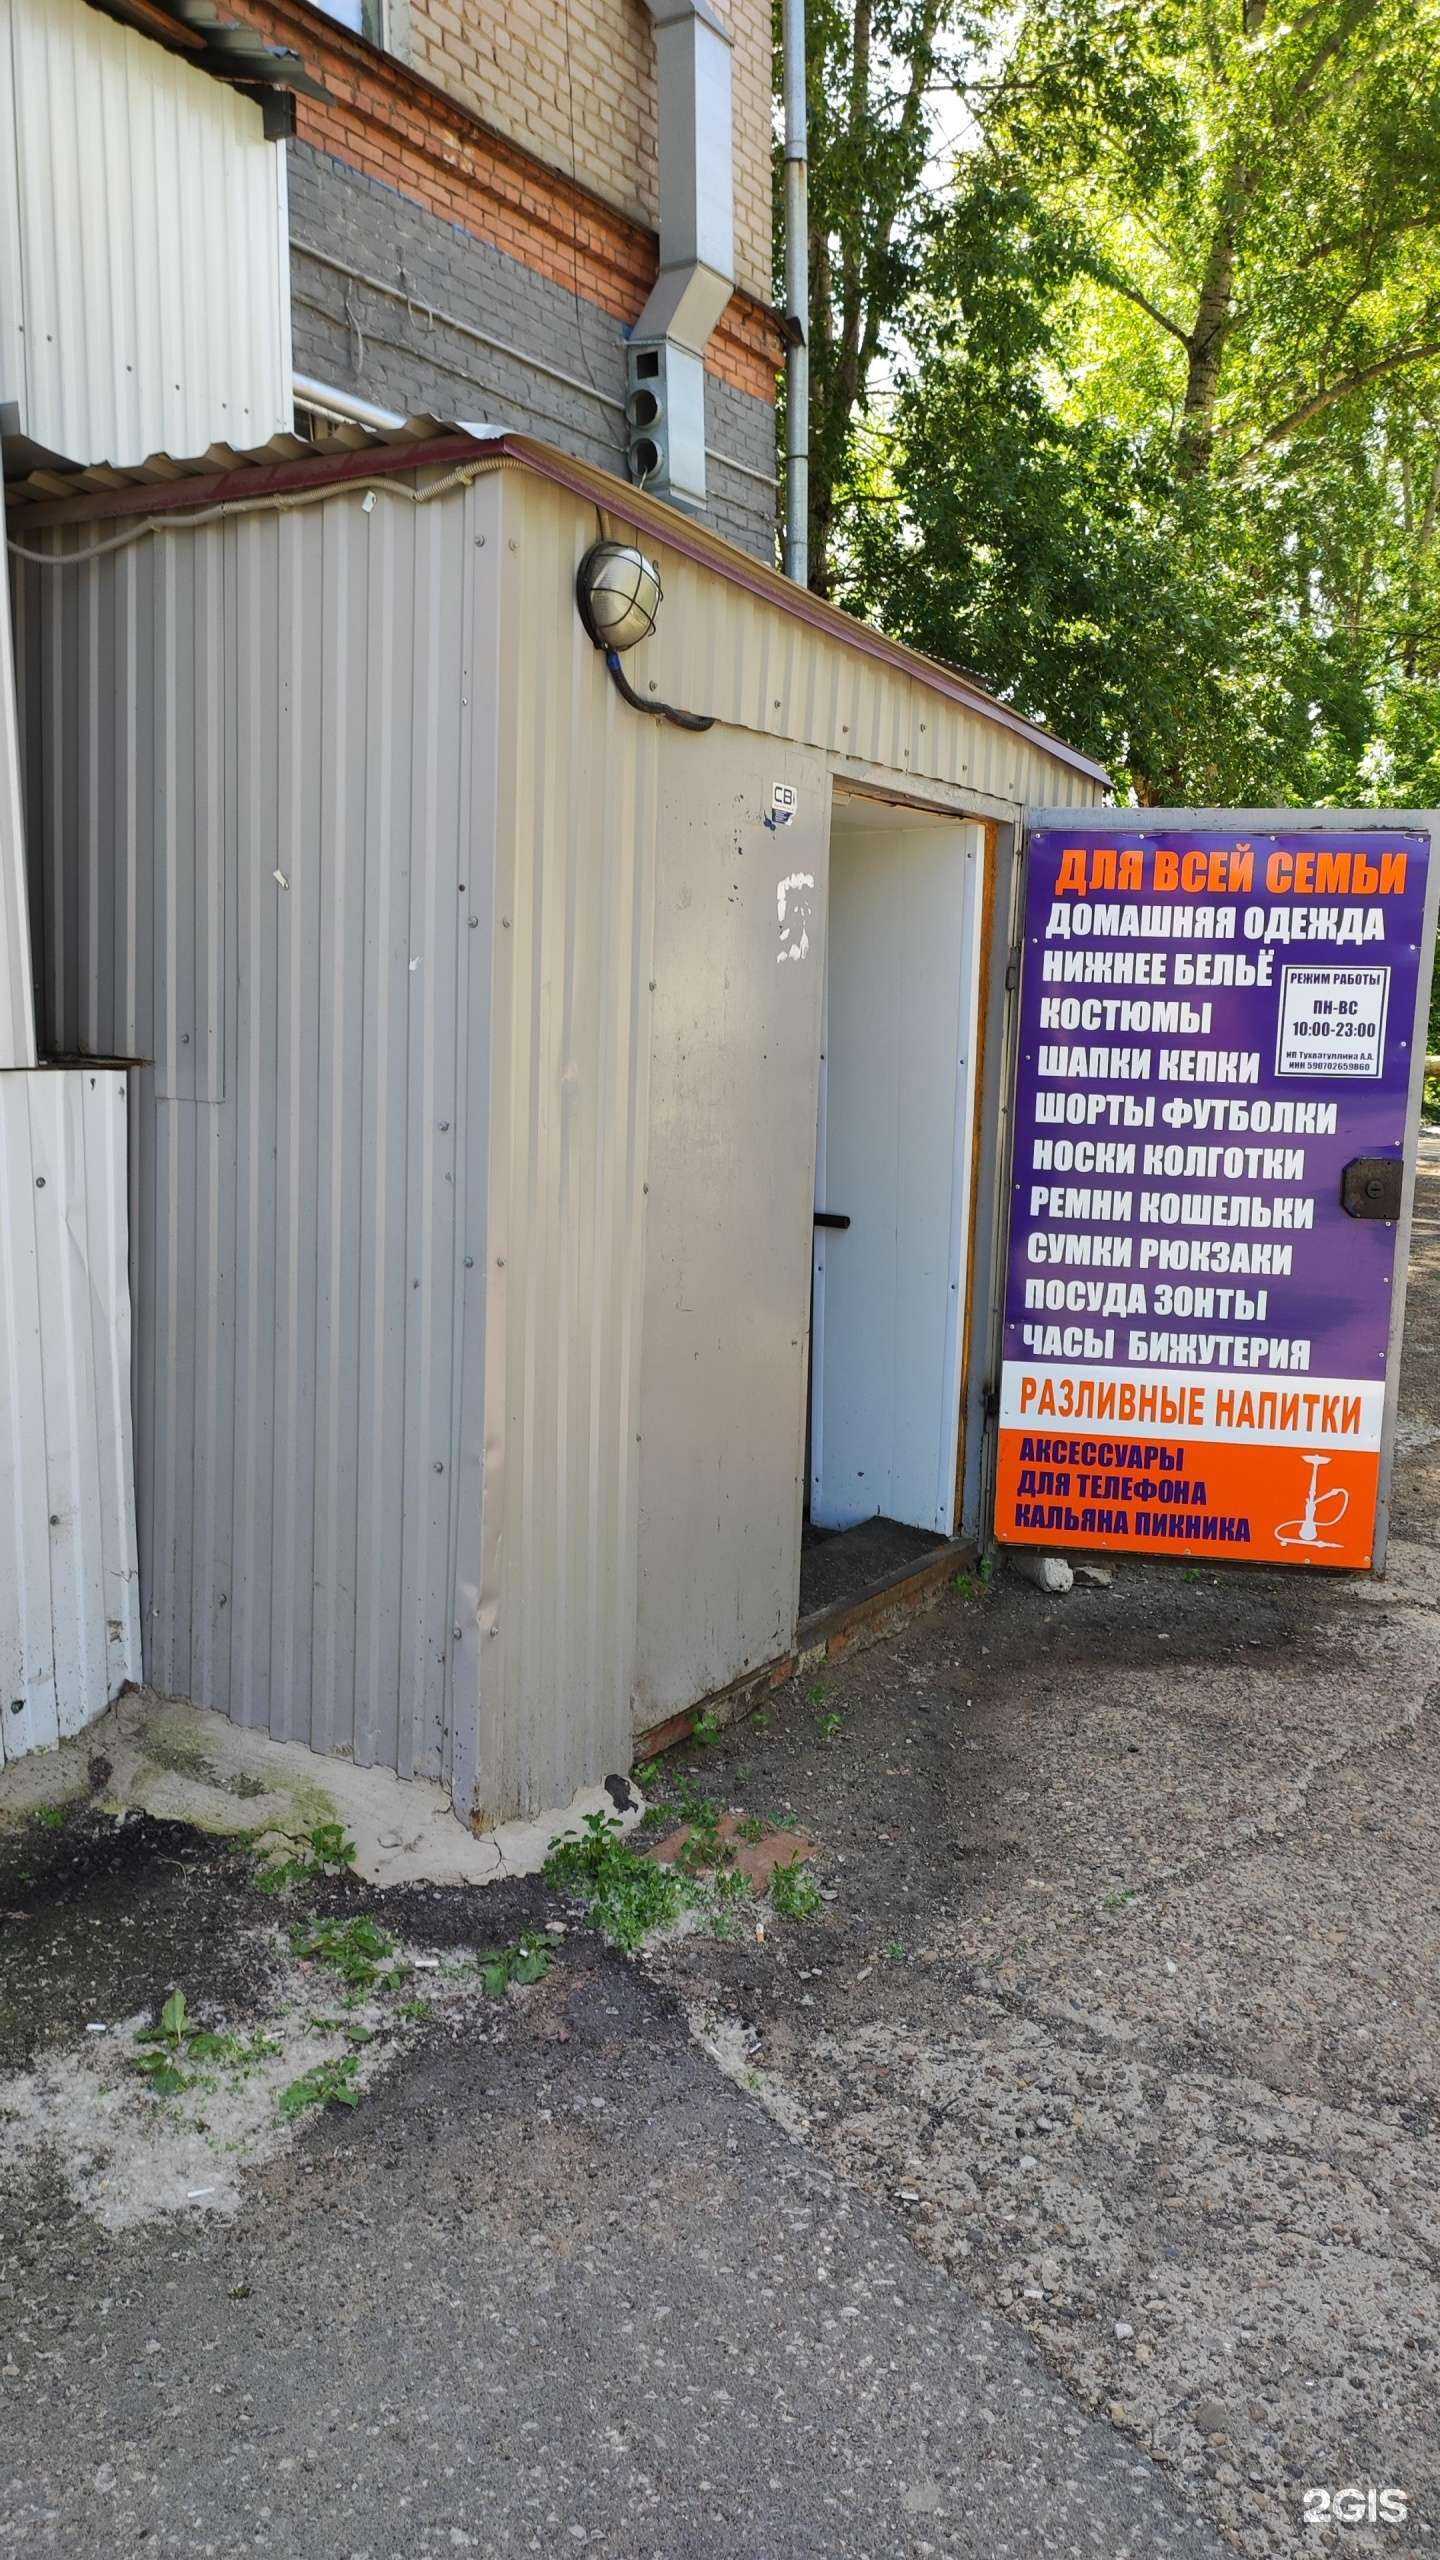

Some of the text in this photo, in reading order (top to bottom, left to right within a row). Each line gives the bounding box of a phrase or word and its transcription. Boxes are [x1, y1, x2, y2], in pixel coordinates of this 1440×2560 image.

[1055, 843, 1408, 896] ДЛЯ ВСЕЙ СЕМЬИ
[1045, 903, 1385, 945] ДОМАШНЯЯ ОДЕЖДА
[1043, 949, 1275, 986] НИЖНЕЕ БЕЛЬЁ
[1290, 973, 1381, 986] РЕЖИМ РАБОТЫ
[1040, 998, 1212, 1034] КОСТЮМЫ
[1313, 1000, 1358, 1015] ПН-ВС
[1293, 1021, 1376, 1038] 10:00-23:00
[1037, 1046, 1260, 1083] ШАПКИ КЕПКИ
[1288, 1062, 1306, 1070] ИНН
[1035, 1092, 1338, 1135] ШОРТЫ ФУТБОЛКИ
[1032, 1140, 1304, 1180] НОСКИ КОЛГОТКИ
[1030, 1186, 1314, 1229] РЕМНИ КОШЕЛЬКИ
[1027, 1232, 1293, 1275] СУМКИ РЮКЗАКИ
[1025, 1280, 1267, 1320] ПОСУДА ЗОНТЫ
[1022, 1325, 1310, 1370] ЧАСЫ БИЖУТЕРИЯ
[1020, 1377, 1361, 1434] РАЗЛИВНЫЕ НАПИТКИ
[1019, 1438, 1184, 1471] АКСЕССУАРЫ
[1017, 1470, 1207, 1505] ДЛЯ ТЕЛЕФОНА
[1014, 1504, 1250, 1542] КАЛЬЯНА ПИКНИКА
